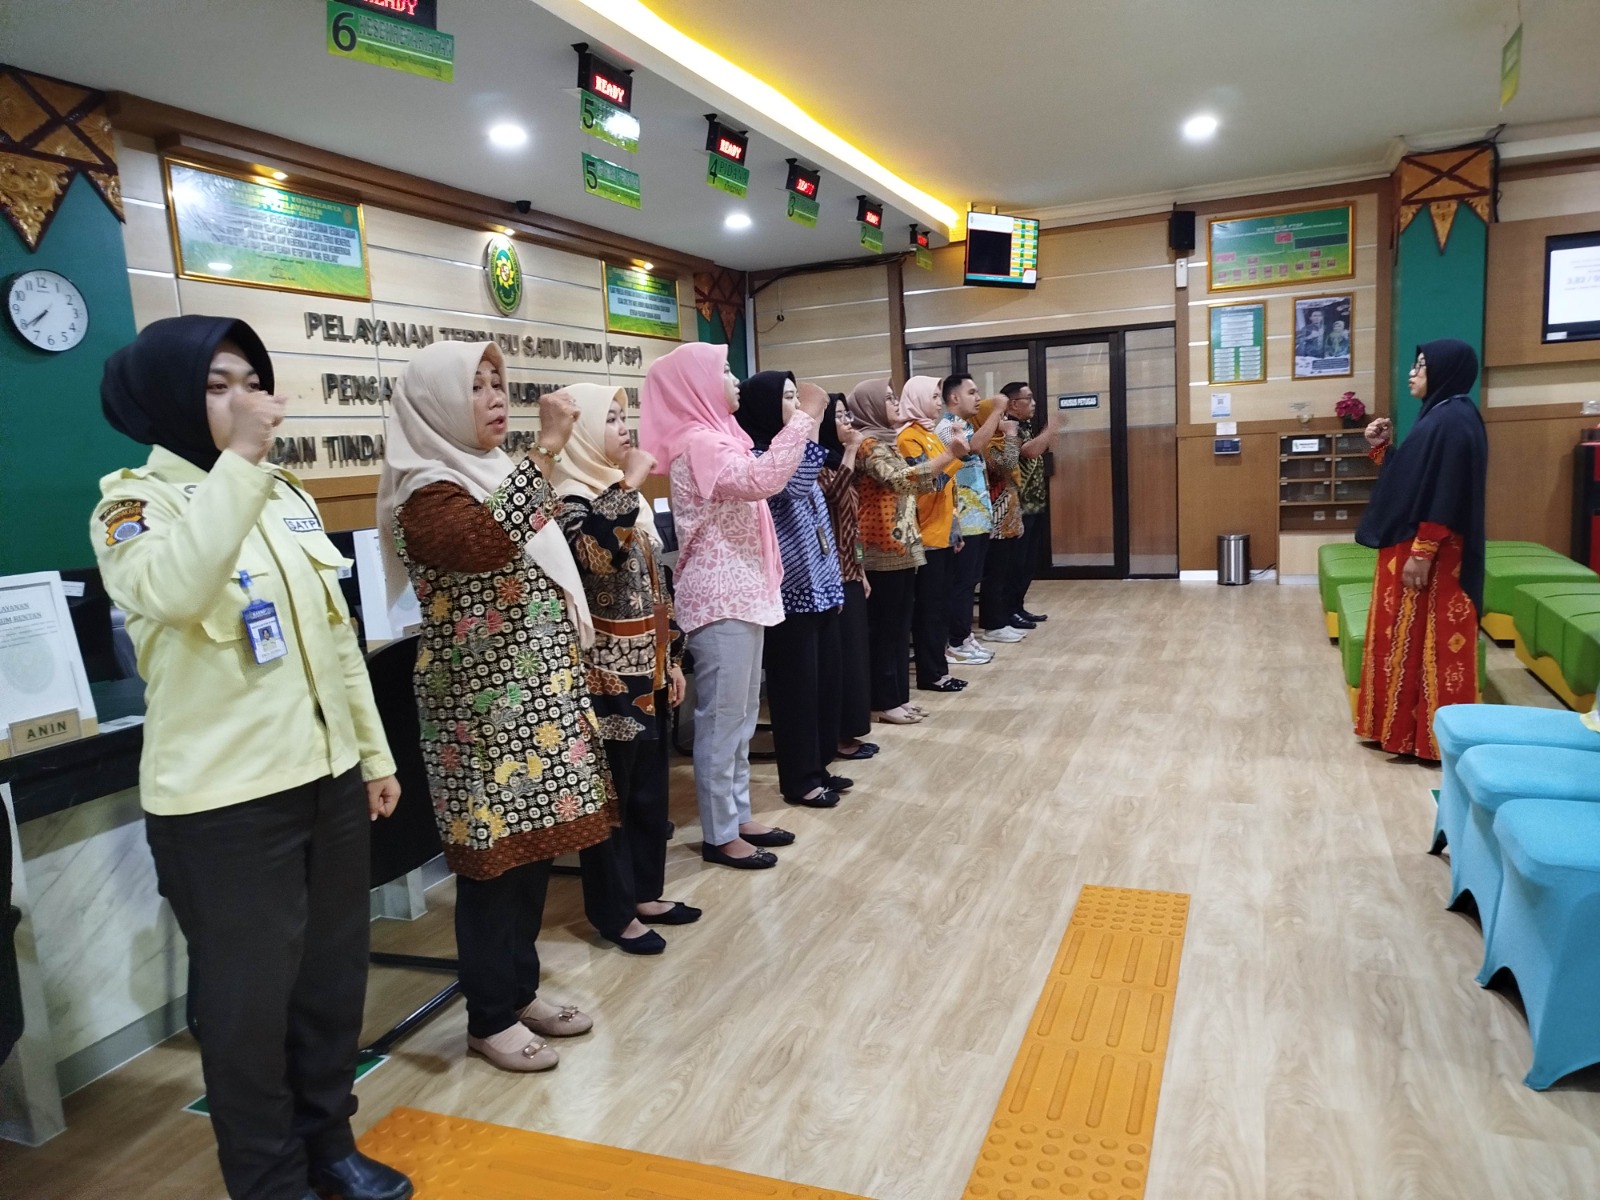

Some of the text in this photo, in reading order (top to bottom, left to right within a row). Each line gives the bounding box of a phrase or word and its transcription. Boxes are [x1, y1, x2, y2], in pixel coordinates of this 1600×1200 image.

[332, 11, 356, 51] 6
[594, 75, 625, 103] READY
[583, 98, 594, 129] 5
[719, 139, 742, 159] READY
[586, 160, 598, 190] 5
[709, 159, 718, 184] 4
[787, 195, 796, 217] 3
[26, 280, 33, 291] 11
[36, 277, 47, 288] 12
[55, 283, 60, 293] 1
[15, 290, 26, 301] 10
[66, 294, 73, 306] 2
[12, 304, 20, 315] 9
[73, 308, 79, 319] 3
[20, 319, 28, 330] 8
[69, 322, 76, 332] 4
[33, 330, 40, 340] 7
[47, 334, 55, 345] 6
[61, 331, 68, 342] 5
[304, 312, 434, 348] PELAYANAN
[522, 335, 561, 359] SATU
[563, 340, 603, 363] PINTU
[605, 342, 643, 369] (PTSP)
[267, 434, 386, 469] DAN TINDA
[288, 519, 317, 531] SATP
[13, 612, 42, 622] RENTAN
[27, 720, 68, 740] ANIN
